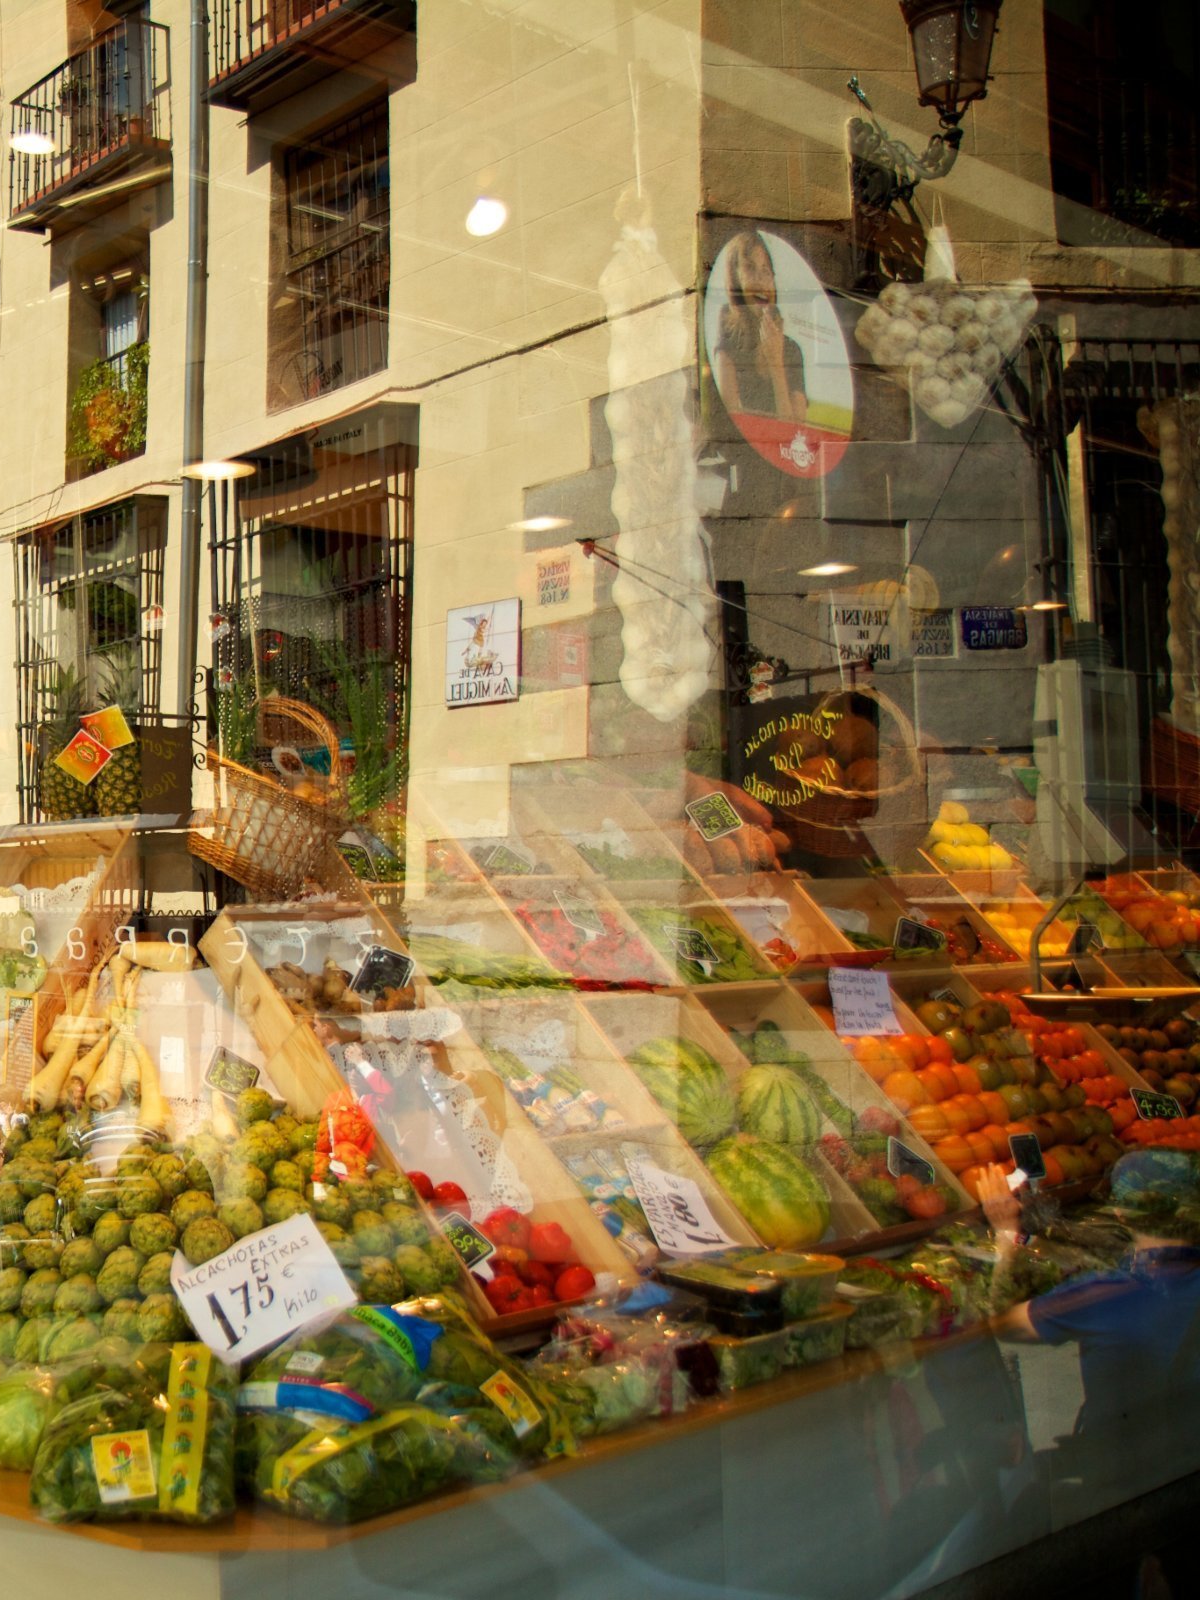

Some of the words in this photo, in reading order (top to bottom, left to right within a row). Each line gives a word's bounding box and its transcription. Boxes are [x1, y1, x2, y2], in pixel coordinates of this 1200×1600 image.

[176, 1234, 279, 1295] ALCACHOFAS
[249, 1234, 310, 1275] EXTRAS
[205, 1272, 275, 1351] 1,75
[386, 1327, 413, 1356] Baby
